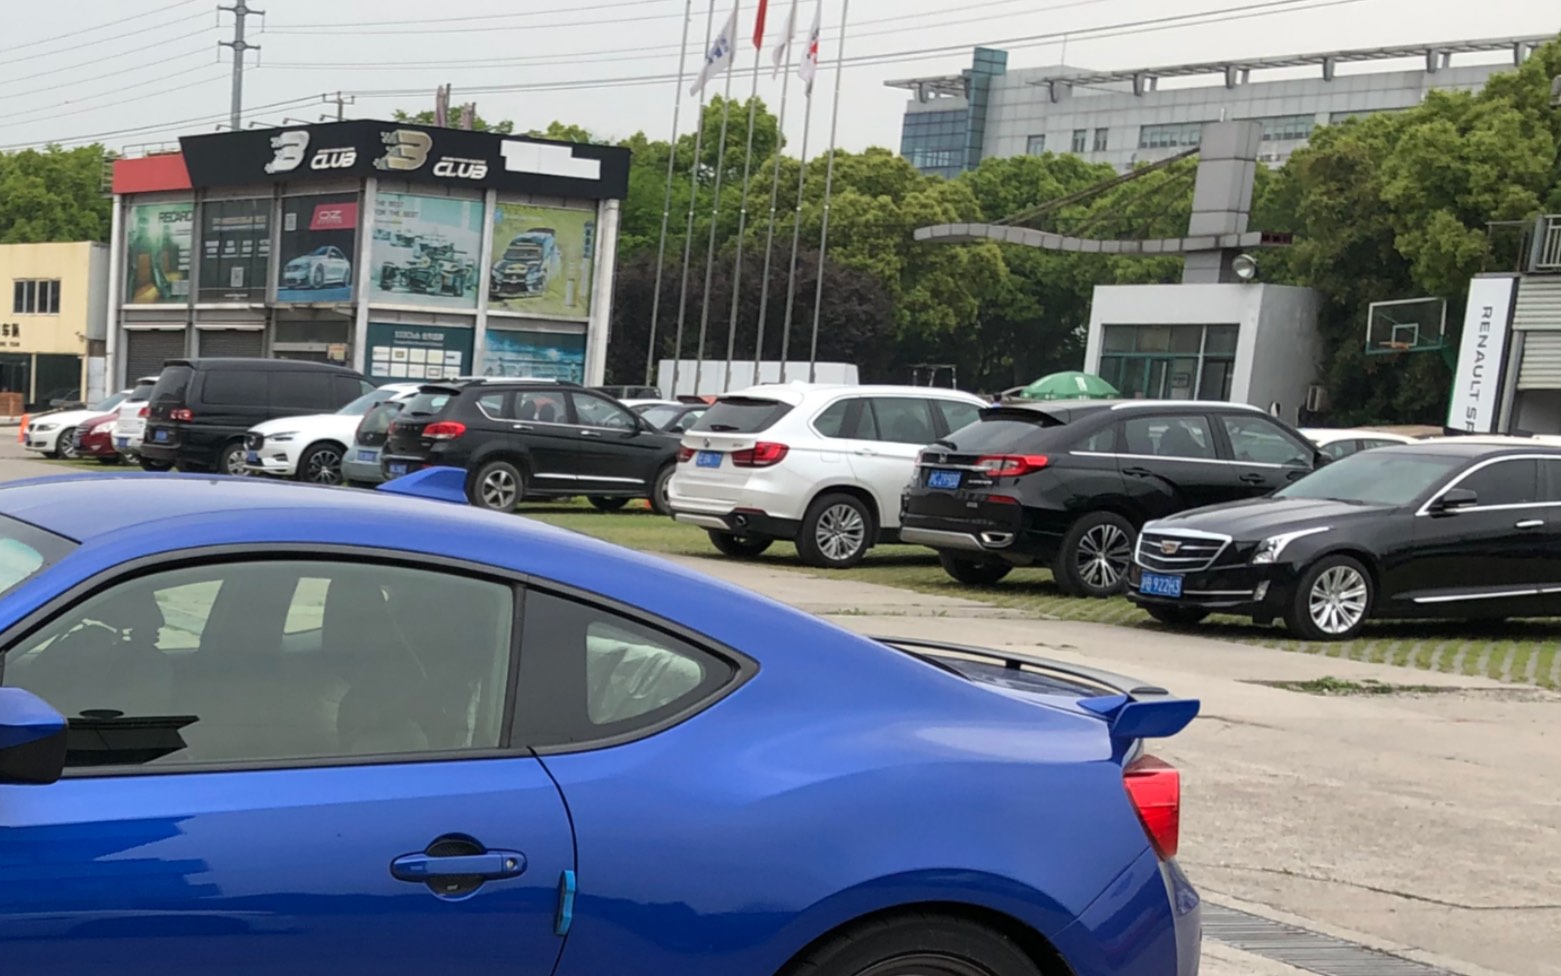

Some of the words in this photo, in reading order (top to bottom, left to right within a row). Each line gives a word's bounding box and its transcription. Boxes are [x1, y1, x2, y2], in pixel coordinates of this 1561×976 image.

[310, 151, 357, 169] CLUB
[433, 161, 489, 180] CLUB
[318, 210, 342, 220] OZ
[1469, 306, 1493, 402] RENAULT
